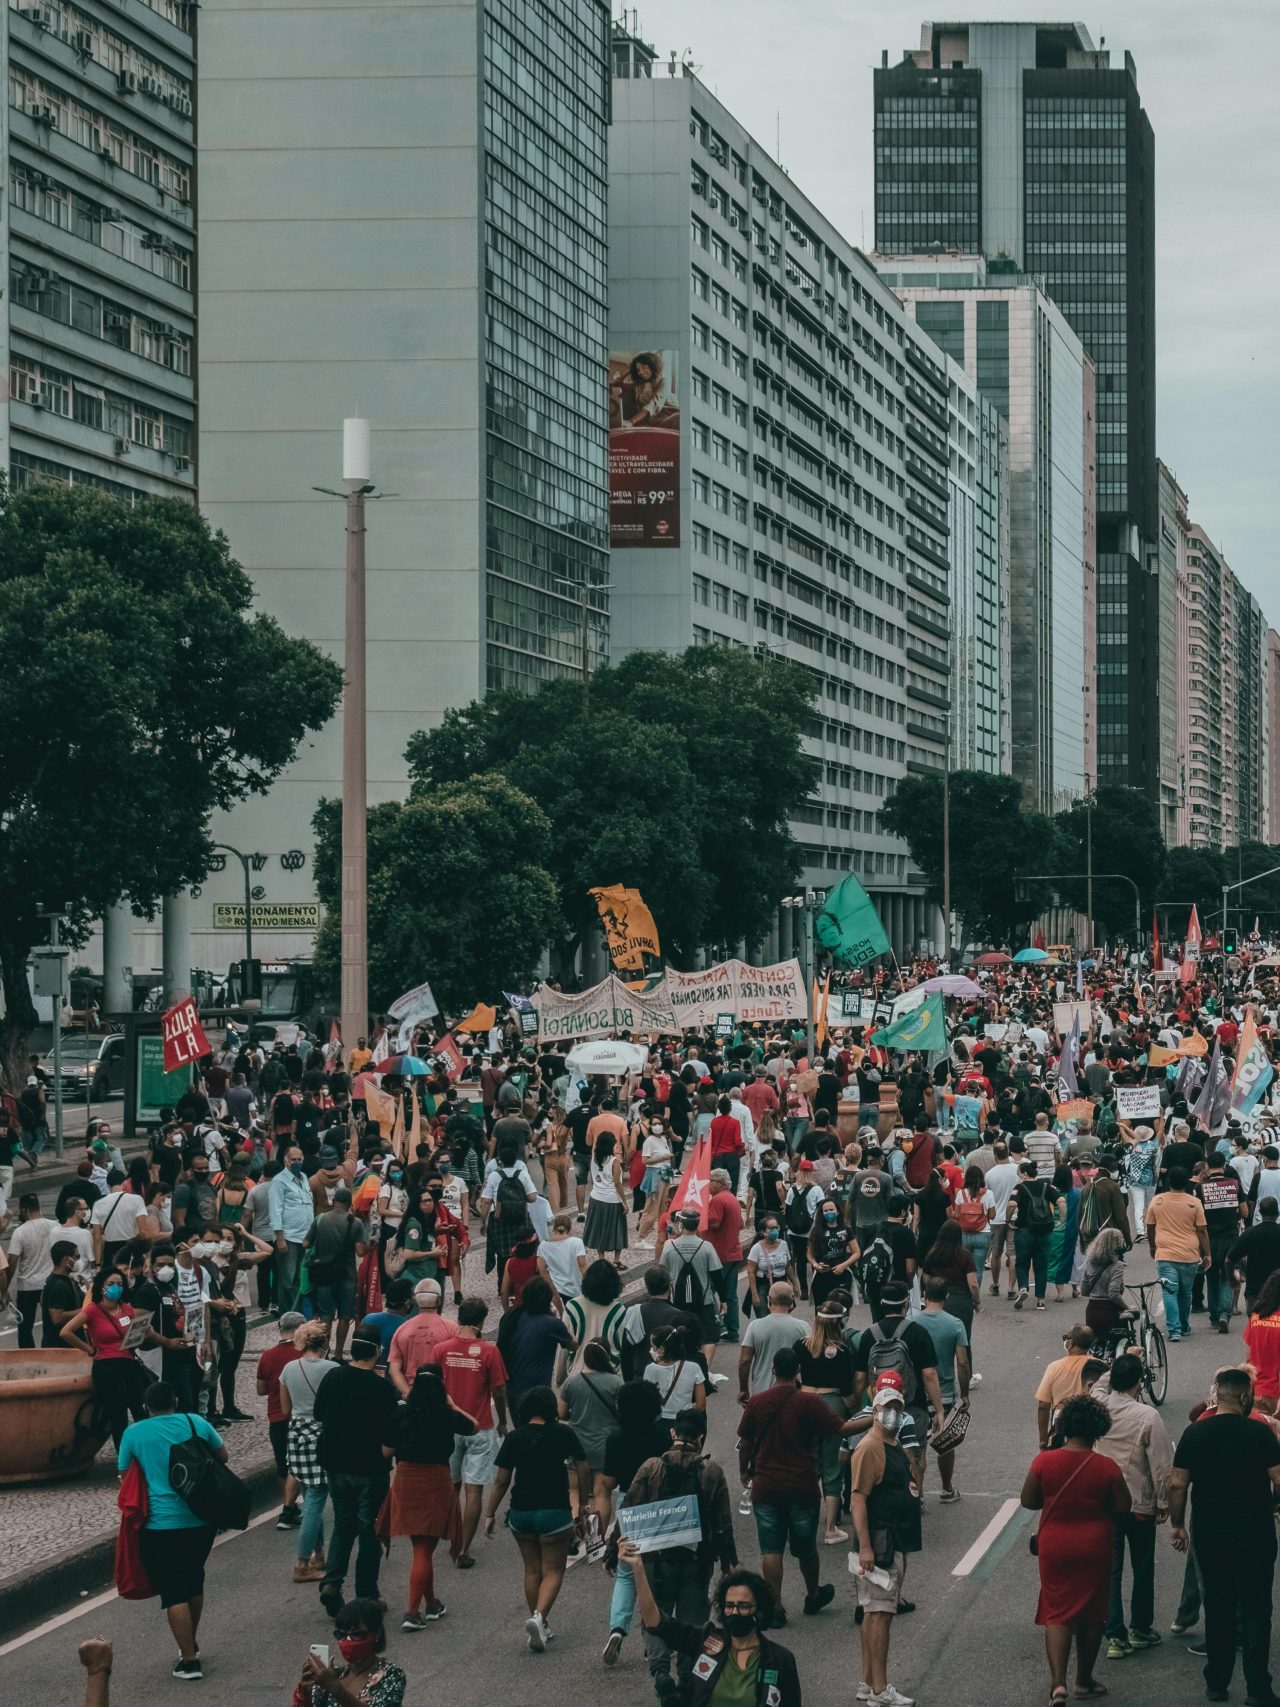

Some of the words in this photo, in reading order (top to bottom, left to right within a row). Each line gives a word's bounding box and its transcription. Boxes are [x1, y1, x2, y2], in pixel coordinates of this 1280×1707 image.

[217, 906, 317, 916] ESTAIONAMENTO
[611, 942, 628, 959] DOS
[165, 1003, 198, 1042] LULA
[623, 1511, 657, 1524] Marielle
[658, 1505, 687, 1518] Franco
